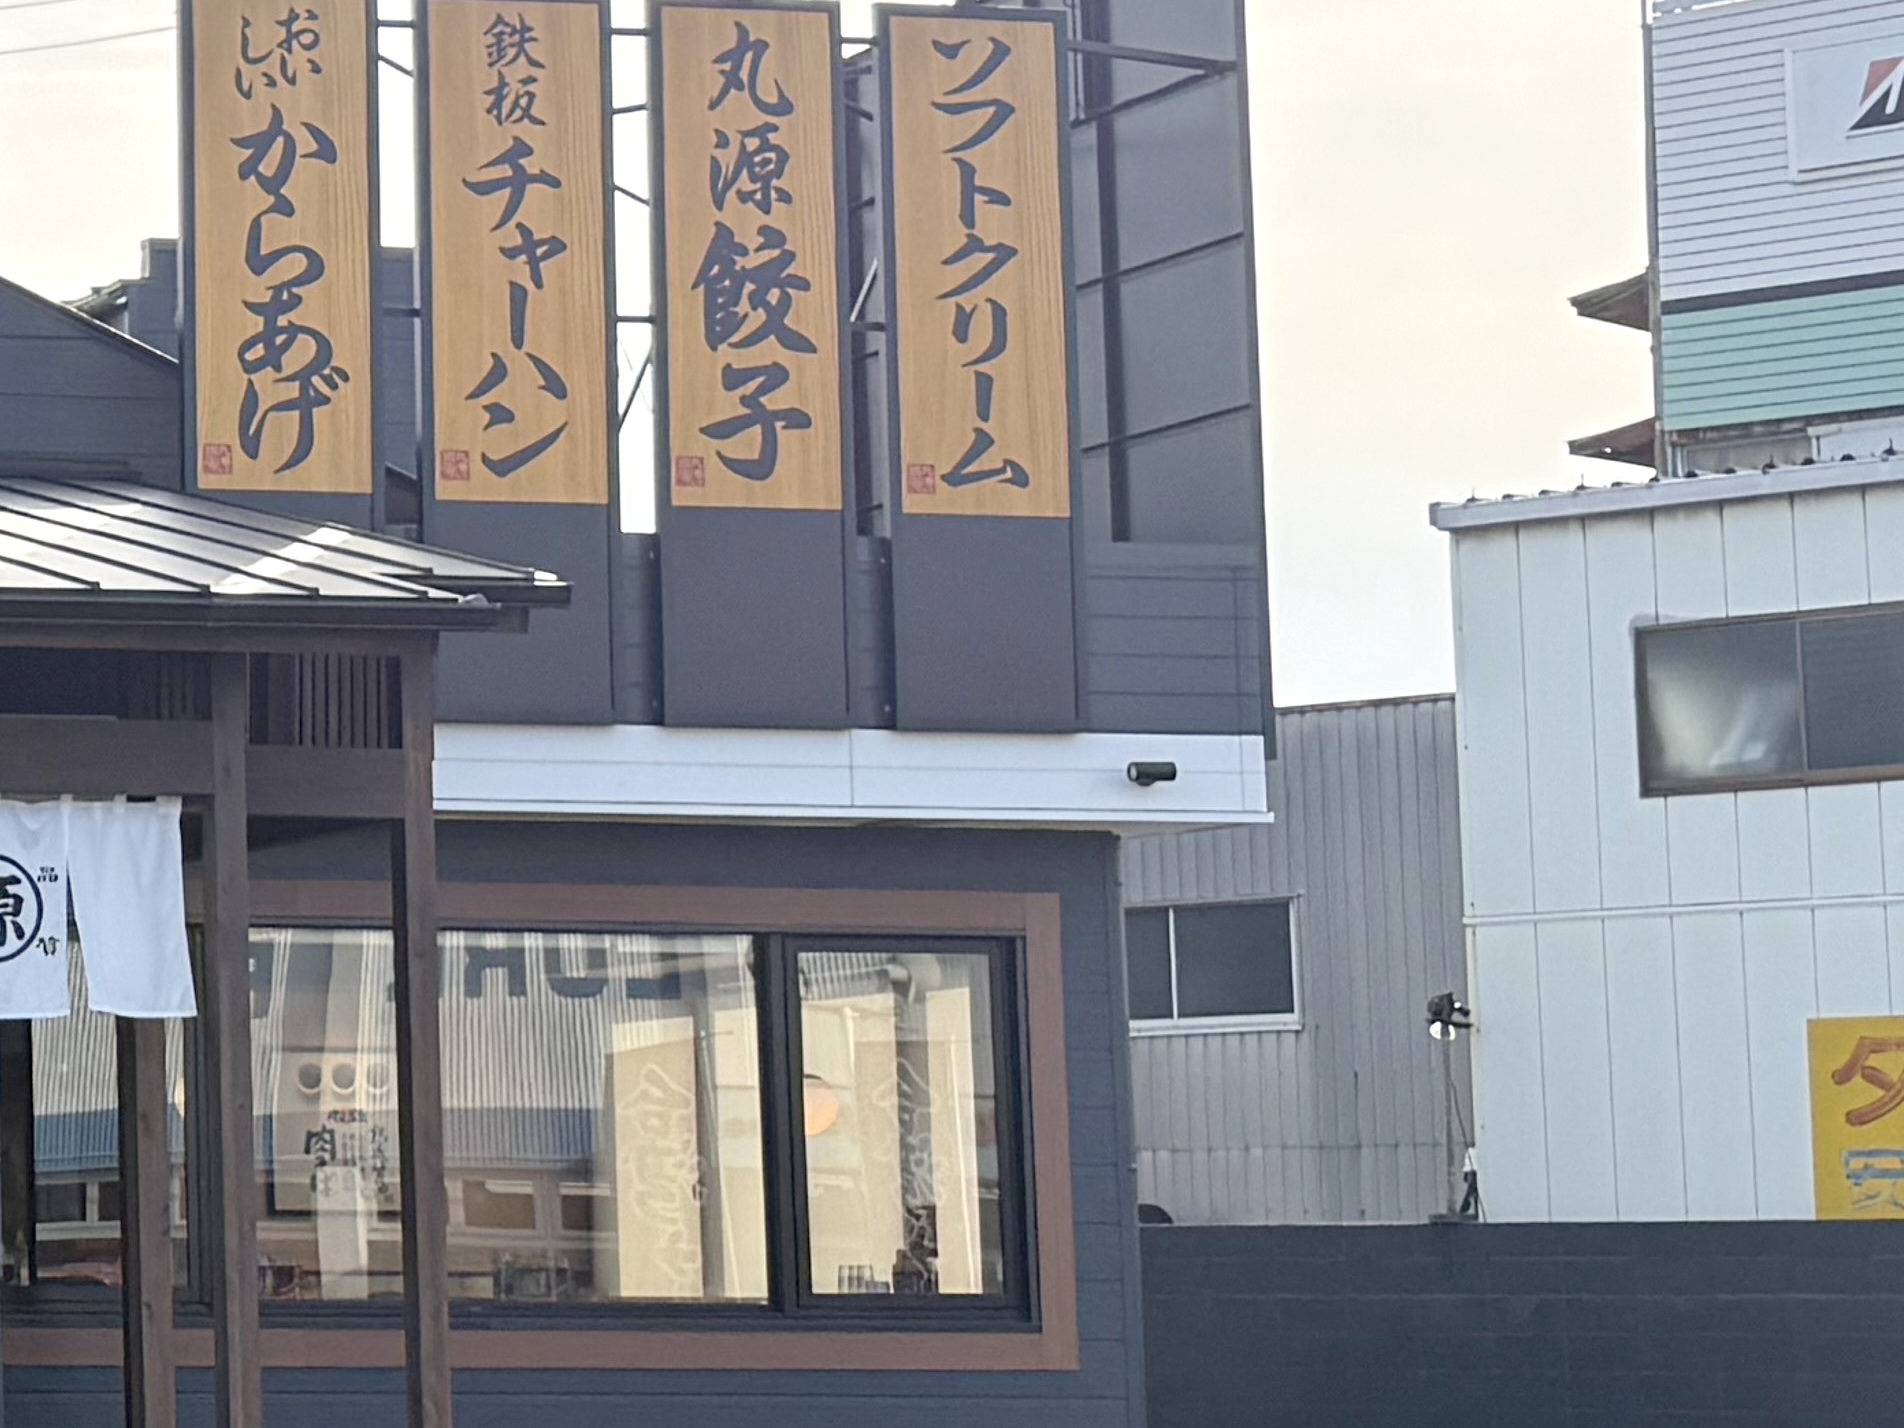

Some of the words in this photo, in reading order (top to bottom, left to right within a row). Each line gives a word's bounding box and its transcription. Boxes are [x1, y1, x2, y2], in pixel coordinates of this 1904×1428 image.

[229, 104, 351, 474] からあげ
[930, 37, 1030, 489] ソフトクリーム
